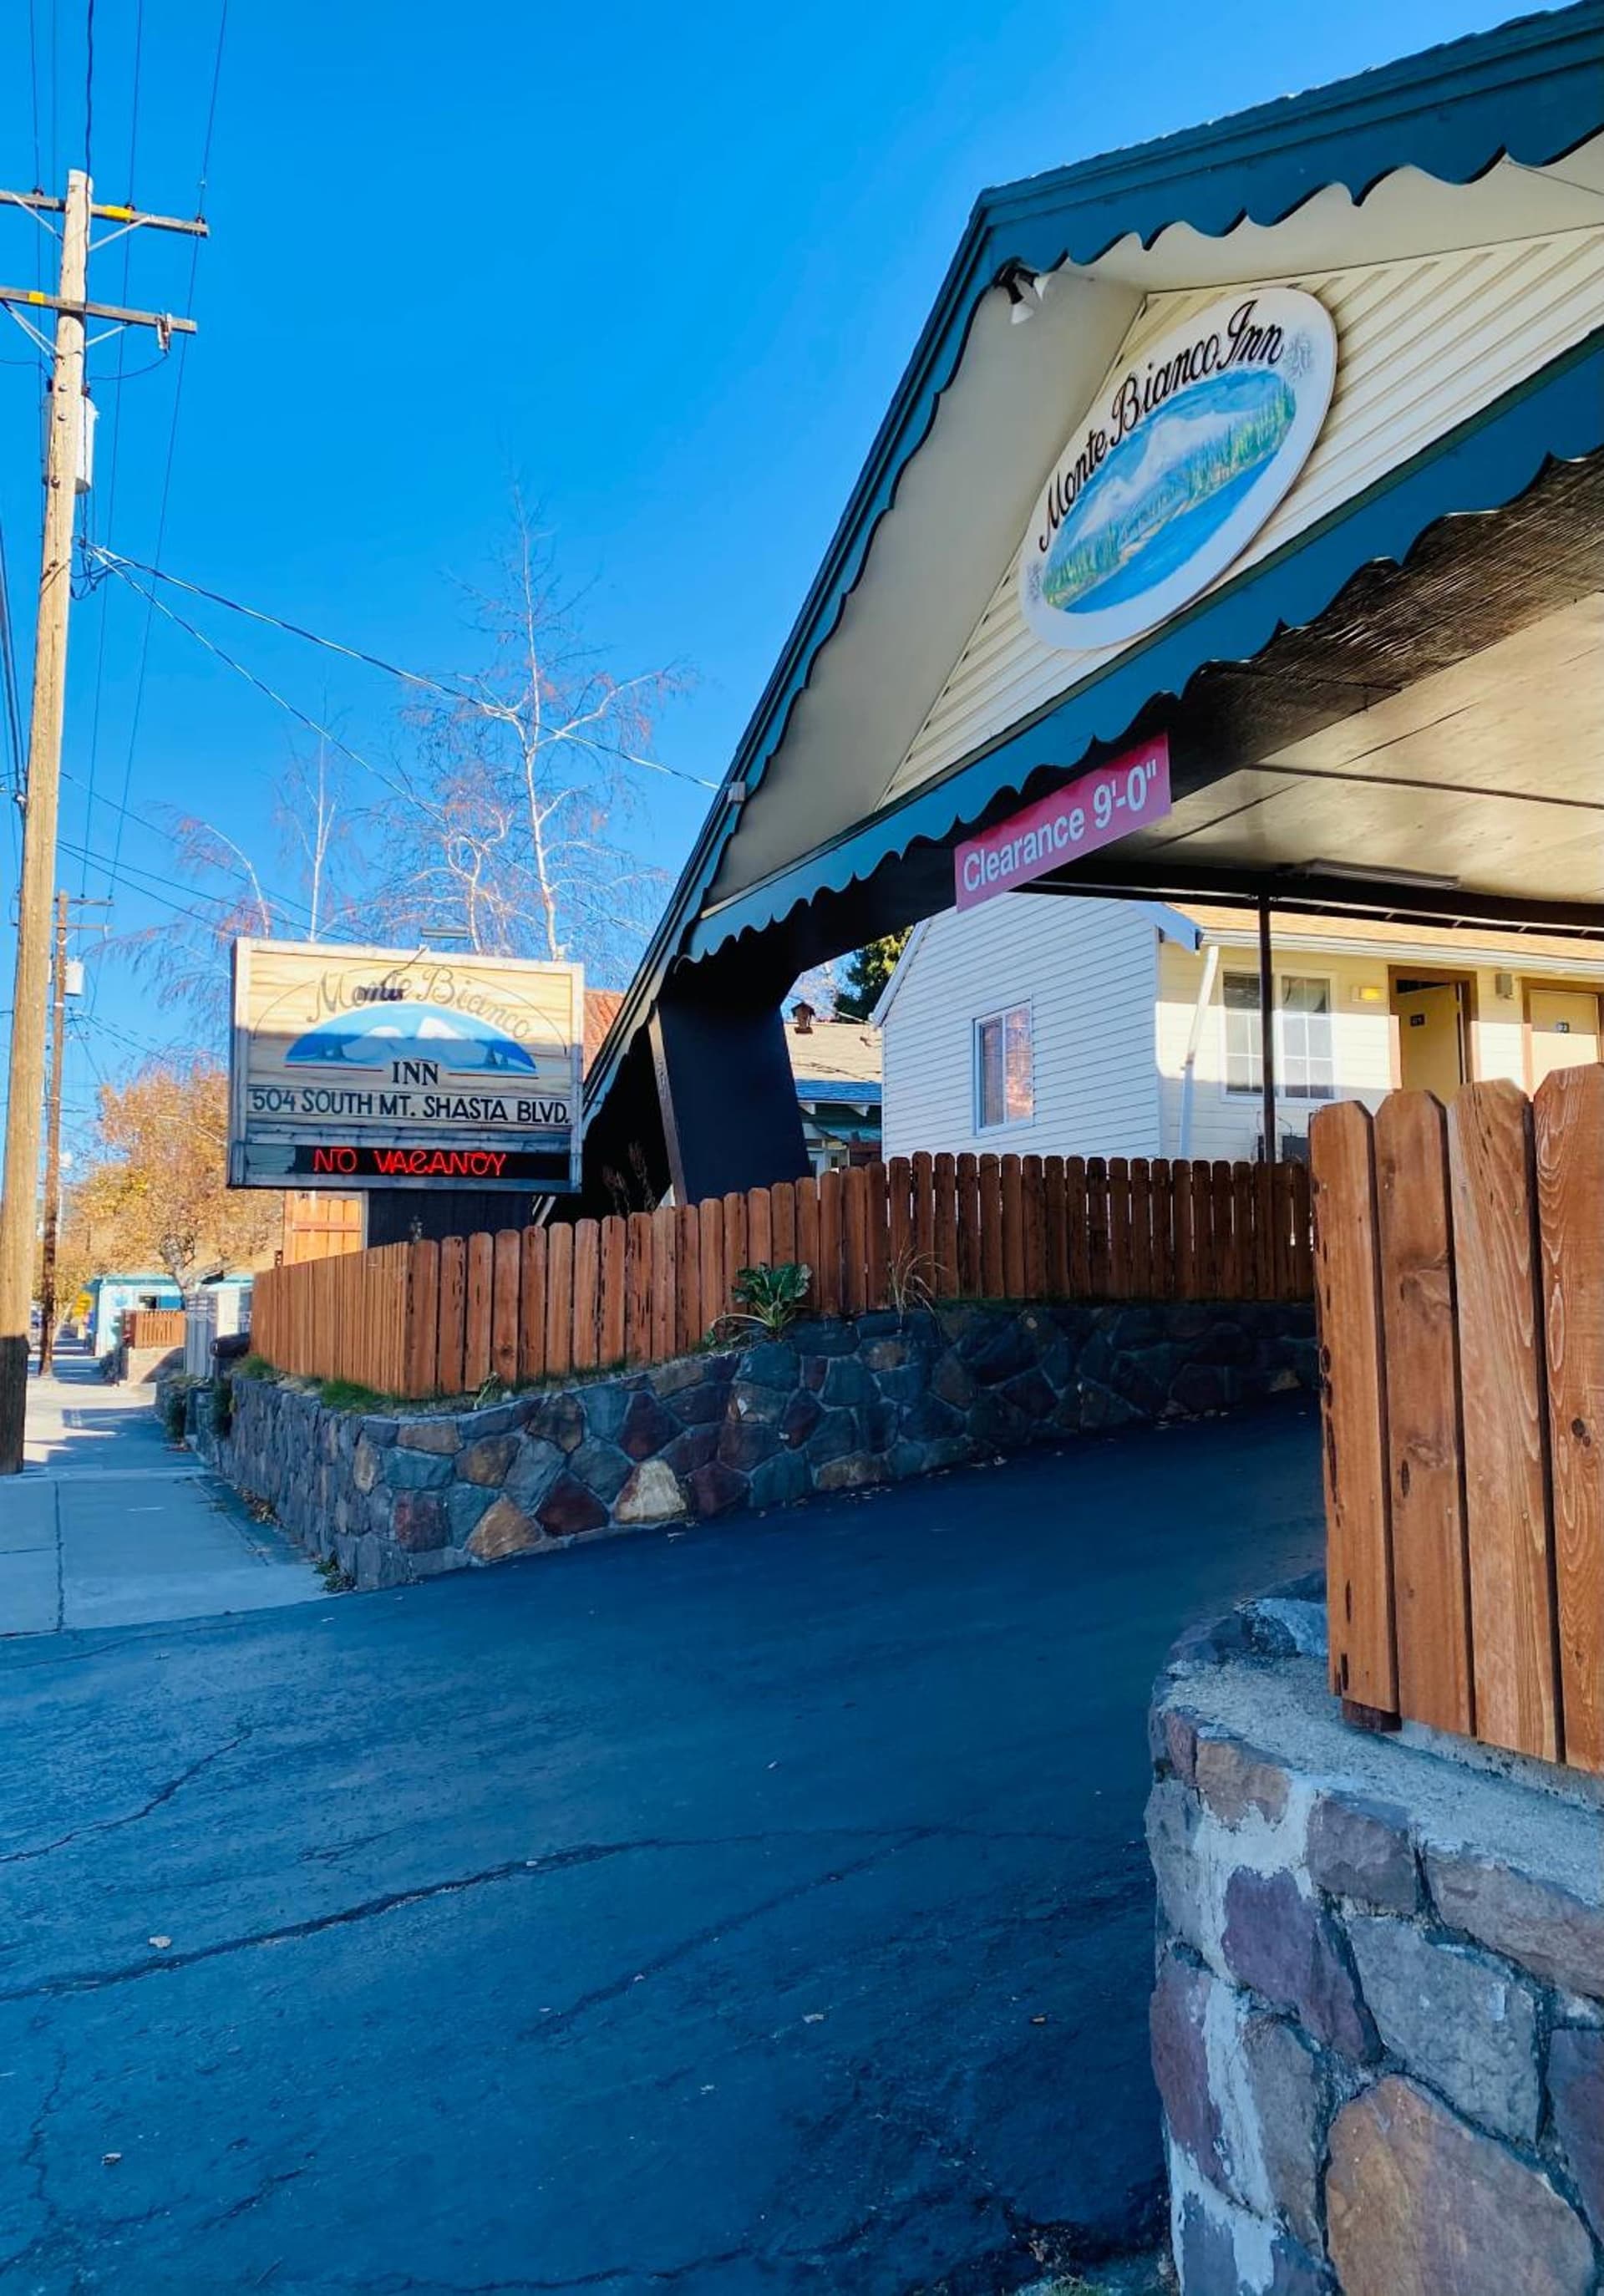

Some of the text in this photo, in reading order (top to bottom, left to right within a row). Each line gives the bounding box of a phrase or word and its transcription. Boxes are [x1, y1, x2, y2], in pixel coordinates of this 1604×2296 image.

[1038, 299, 1284, 552] Monte Bianco Inn
[963, 758, 1157, 891] Clearance 9'-0"
[306, 966, 530, 1039] Monte Bianco
[392, 1061, 439, 1086] INN
[251, 1088, 570, 1125] 504 SOUTH MT. SHASTA BLVD.
[313, 1148, 507, 1177] NO VACANCY
